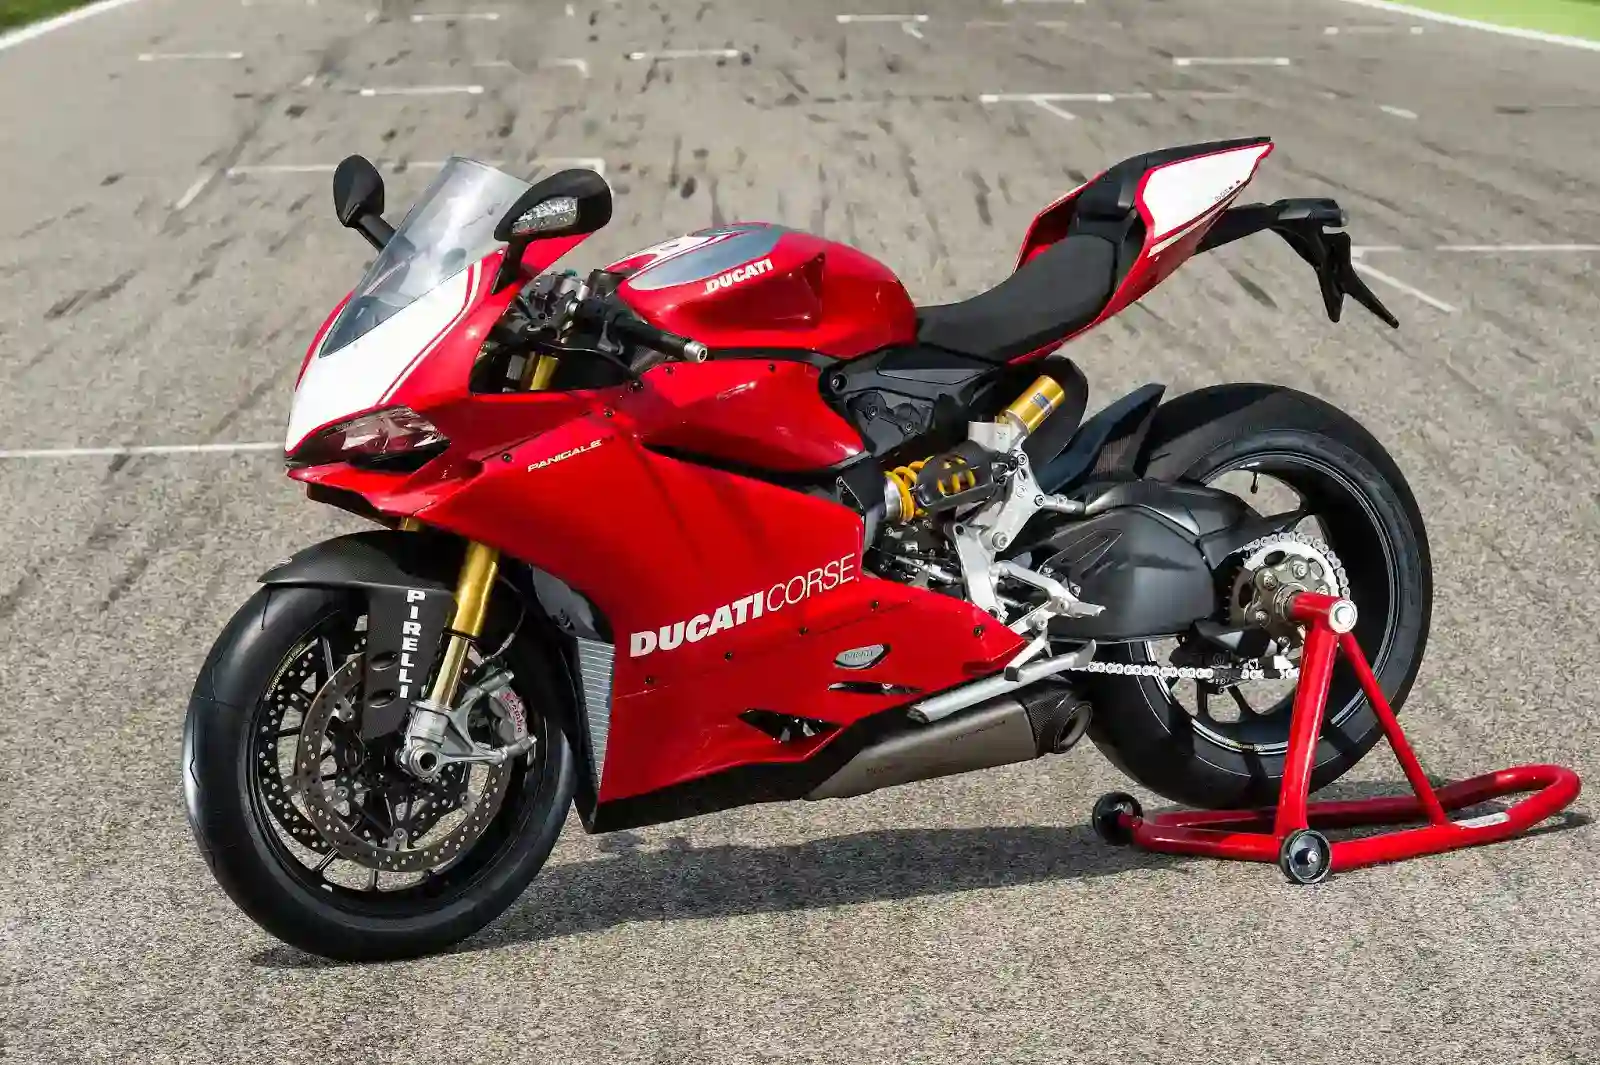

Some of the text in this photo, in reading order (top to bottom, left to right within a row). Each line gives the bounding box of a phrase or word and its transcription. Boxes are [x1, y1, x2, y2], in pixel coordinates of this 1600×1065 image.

[704, 258, 774, 295] DUCATI
[527, 439, 602, 472] PANIGALE
[630, 552, 855, 657] DUCATI CORSE
[398, 589, 426, 699] PIRELLI
